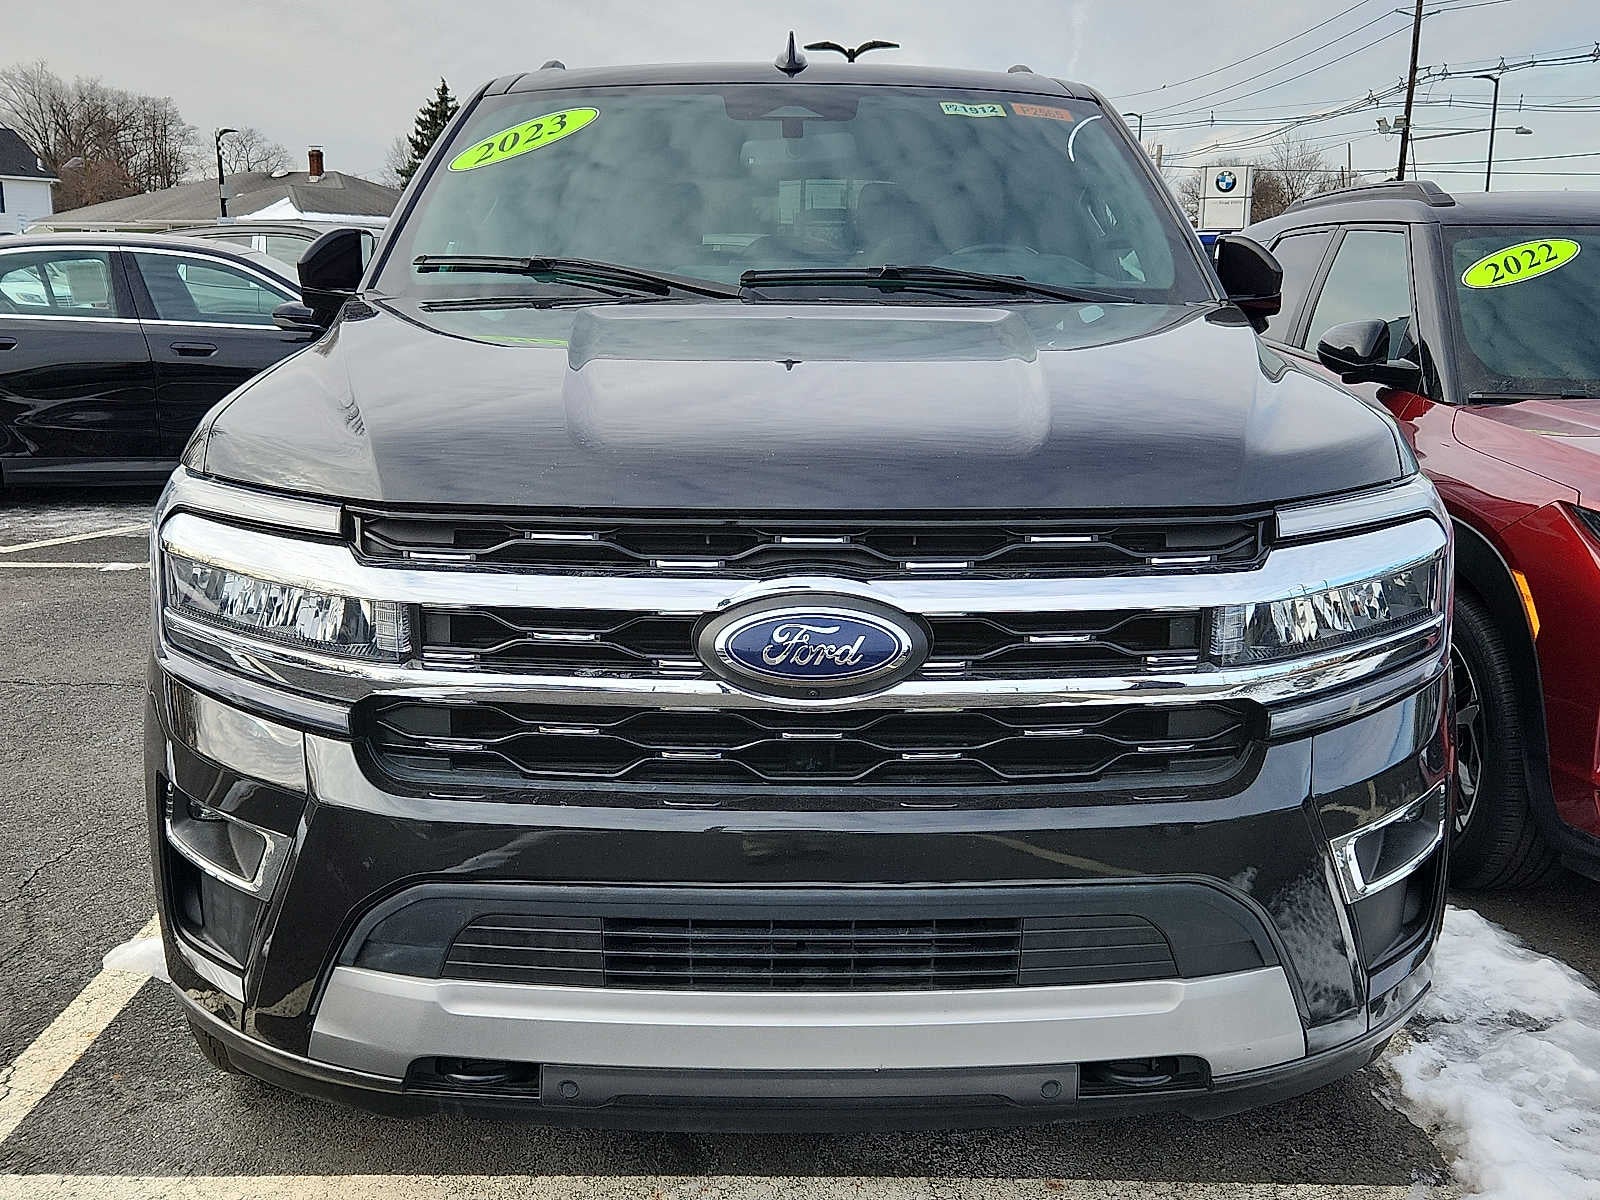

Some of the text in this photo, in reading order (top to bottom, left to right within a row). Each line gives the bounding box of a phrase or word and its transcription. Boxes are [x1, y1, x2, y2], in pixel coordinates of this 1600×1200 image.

[474, 113, 567, 165] 2023
[1484, 243, 1559, 283] 2022
[762, 623, 867, 666] Ford
